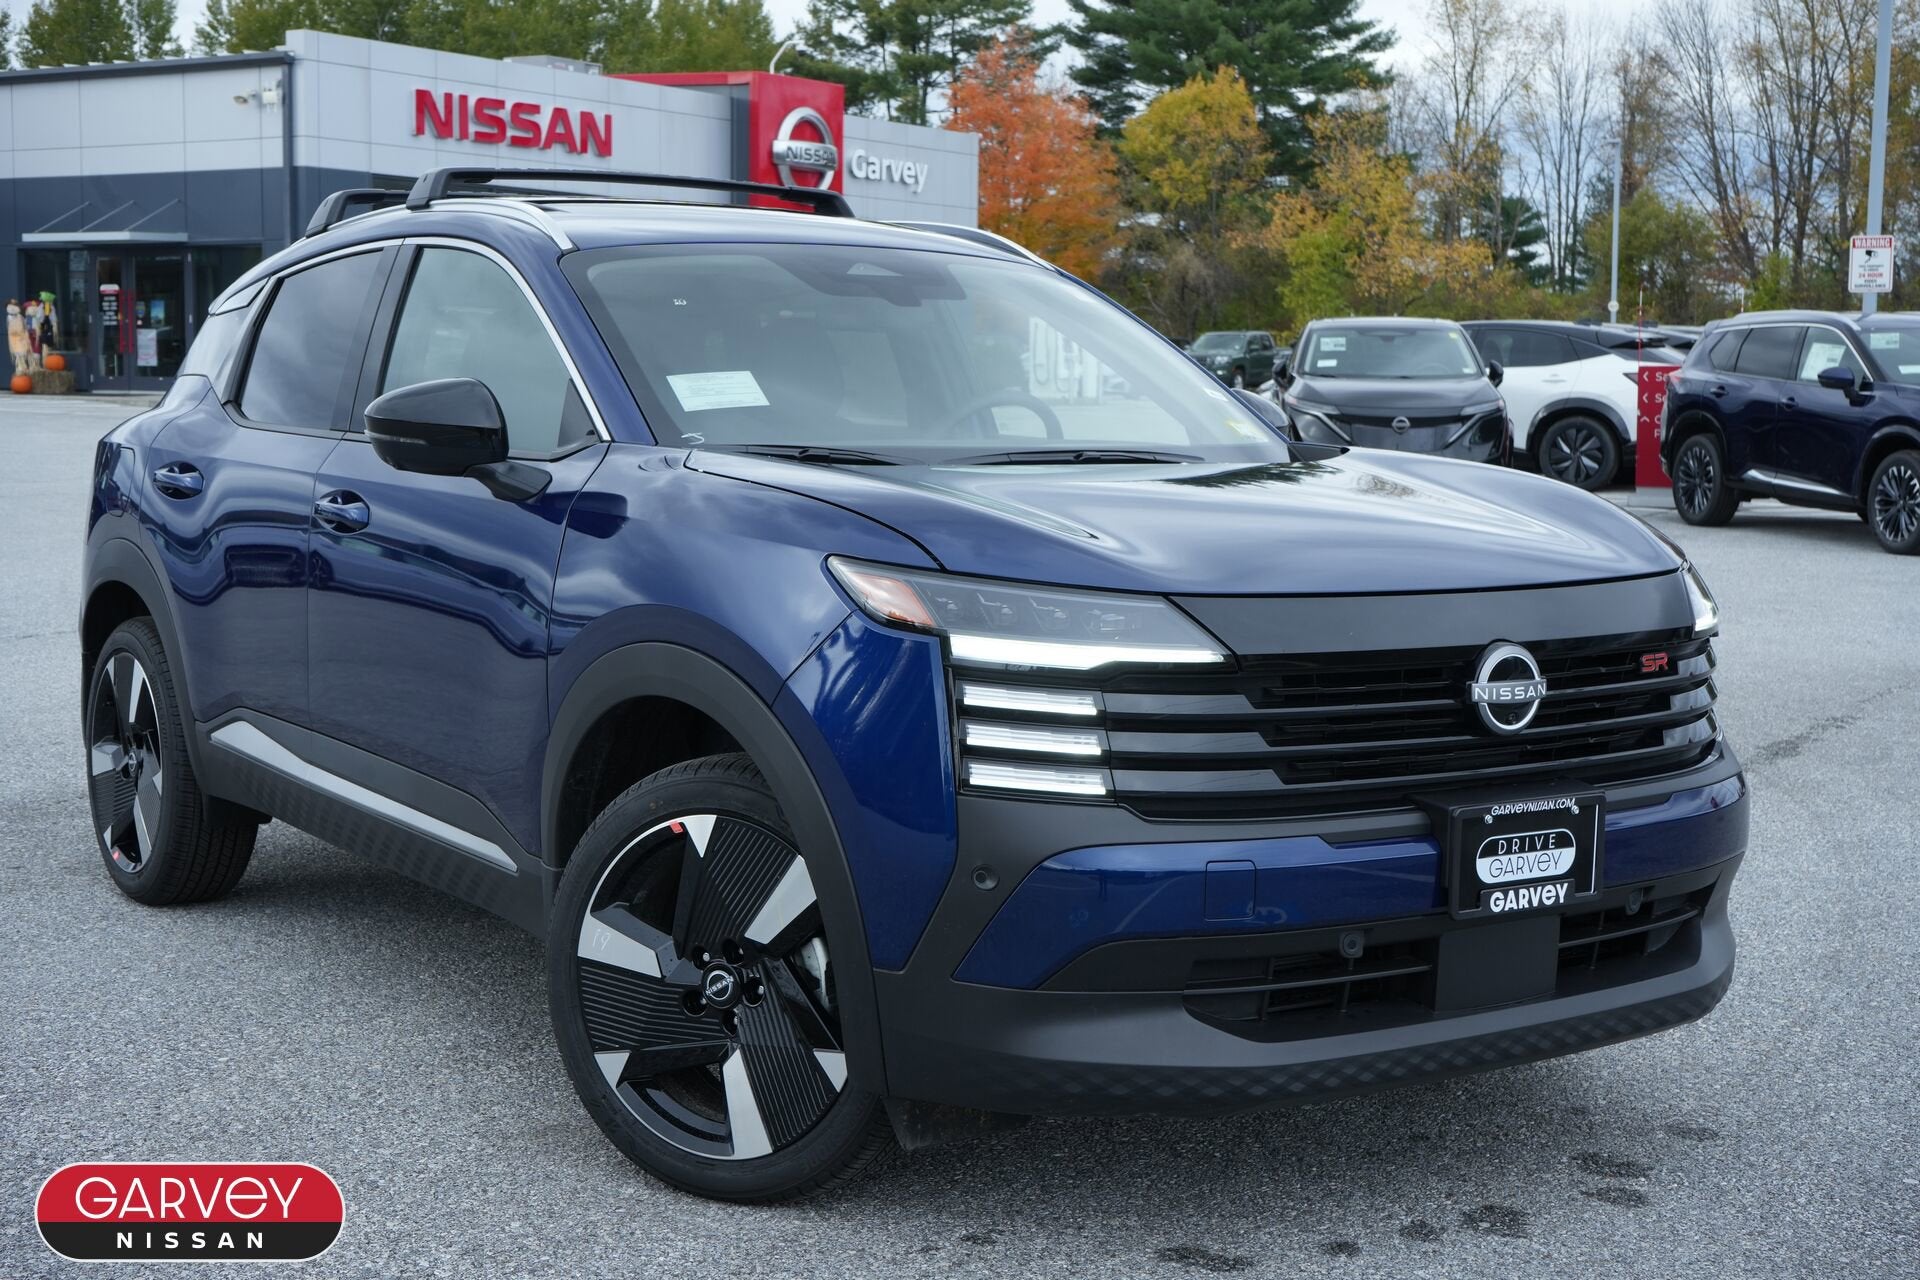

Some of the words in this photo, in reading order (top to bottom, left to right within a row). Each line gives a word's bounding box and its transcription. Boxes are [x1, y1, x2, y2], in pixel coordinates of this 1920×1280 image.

[415, 88, 612, 157] NISSAN
[786, 146, 835, 165] NISSAN
[851, 149, 928, 193] Garvey
[1855, 237, 1890, 248] WARNING
[1641, 652, 1669, 673] SR
[1474, 683, 1546, 700] NISSAN
[1498, 834, 1557, 855] DRIVE
[705, 975, 735, 996] NISSAN
